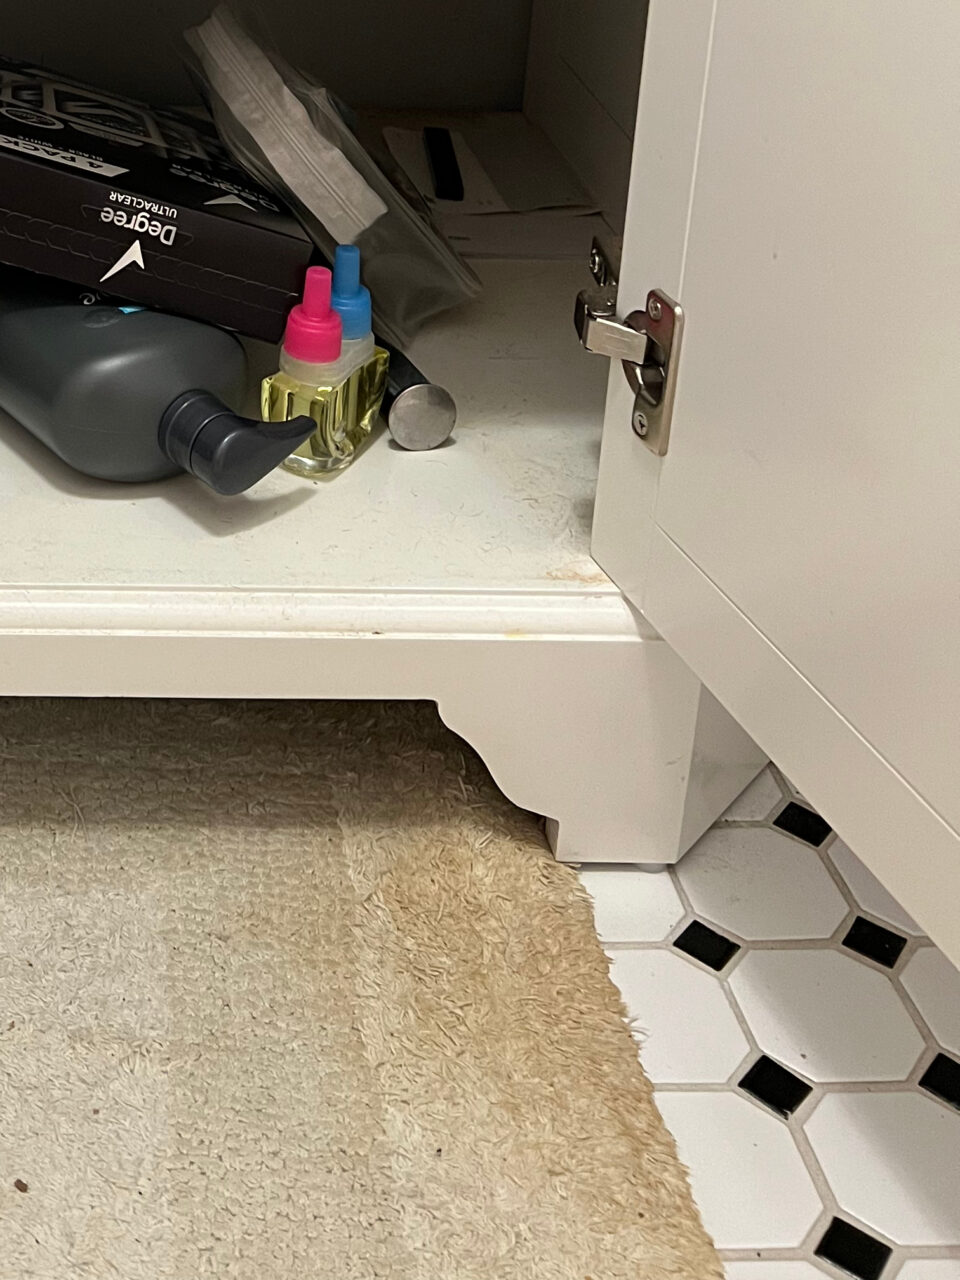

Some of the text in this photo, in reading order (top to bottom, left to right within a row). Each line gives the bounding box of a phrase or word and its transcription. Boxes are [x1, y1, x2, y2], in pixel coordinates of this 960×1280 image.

[2, 137, 103, 169] 4 PACK
[109, 191, 178, 218] ULTRACLEAR
[100, 207, 177, 246] Degree
